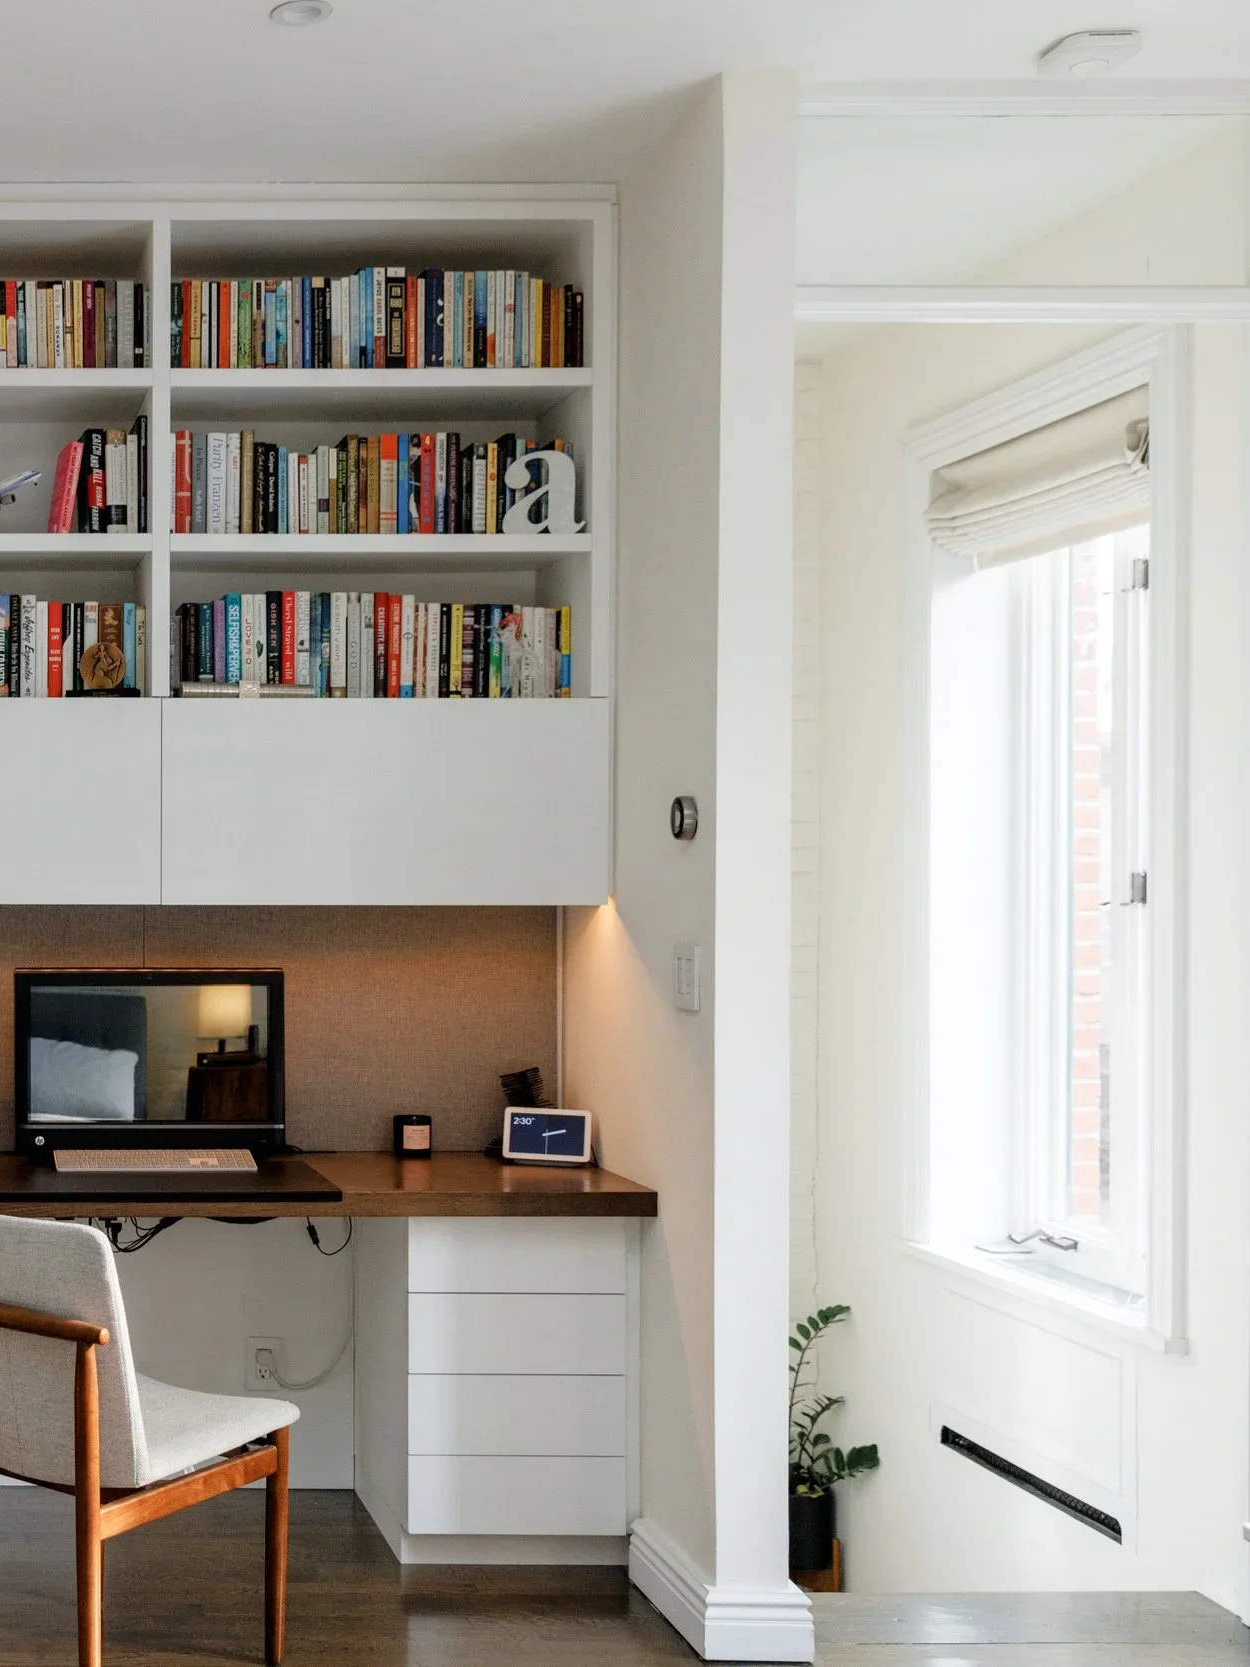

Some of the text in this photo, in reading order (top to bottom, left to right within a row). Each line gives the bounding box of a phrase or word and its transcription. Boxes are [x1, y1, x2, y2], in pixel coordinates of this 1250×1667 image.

[92, 433, 102, 456] CATCH
[196, 447, 204, 456] In
[424, 435, 431, 446] 4
[90, 454, 99, 468] AND
[196, 457, 204, 481] Pieces
[92, 467, 103, 484] KILL
[209, 438, 224, 523] Purity Franzen
[502, 450, 586, 534] a
[62, 498, 70, 528] RELAXATION
[91, 505, 99, 531] FARROW
[377, 606, 385, 642] CREATIVITY,
[22, 616, 35, 683] Jeffrey Eugenides
[283, 597, 293, 680] Cheryl Strayed wild
[377, 643, 385, 656] INC.
[350, 641, 358, 669] GOD
